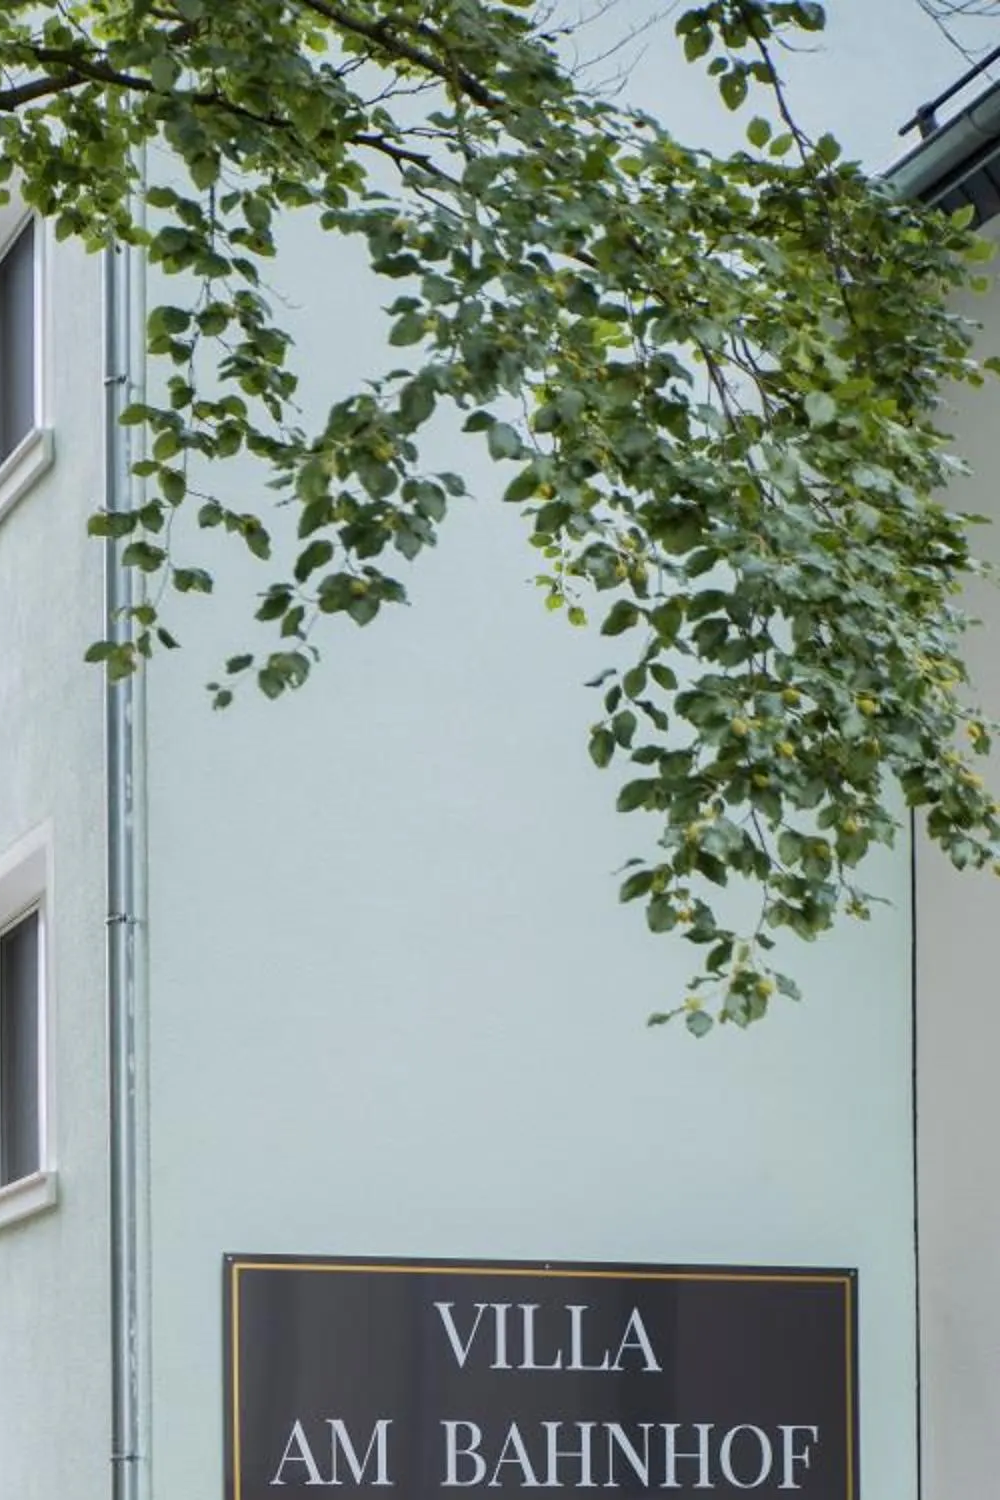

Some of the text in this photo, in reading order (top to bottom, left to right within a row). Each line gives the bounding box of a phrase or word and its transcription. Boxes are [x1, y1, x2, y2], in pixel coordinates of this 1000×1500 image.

[434, 1302, 662, 1371] VILLA
[269, 1418, 818, 1489] AM BAHNHOF
